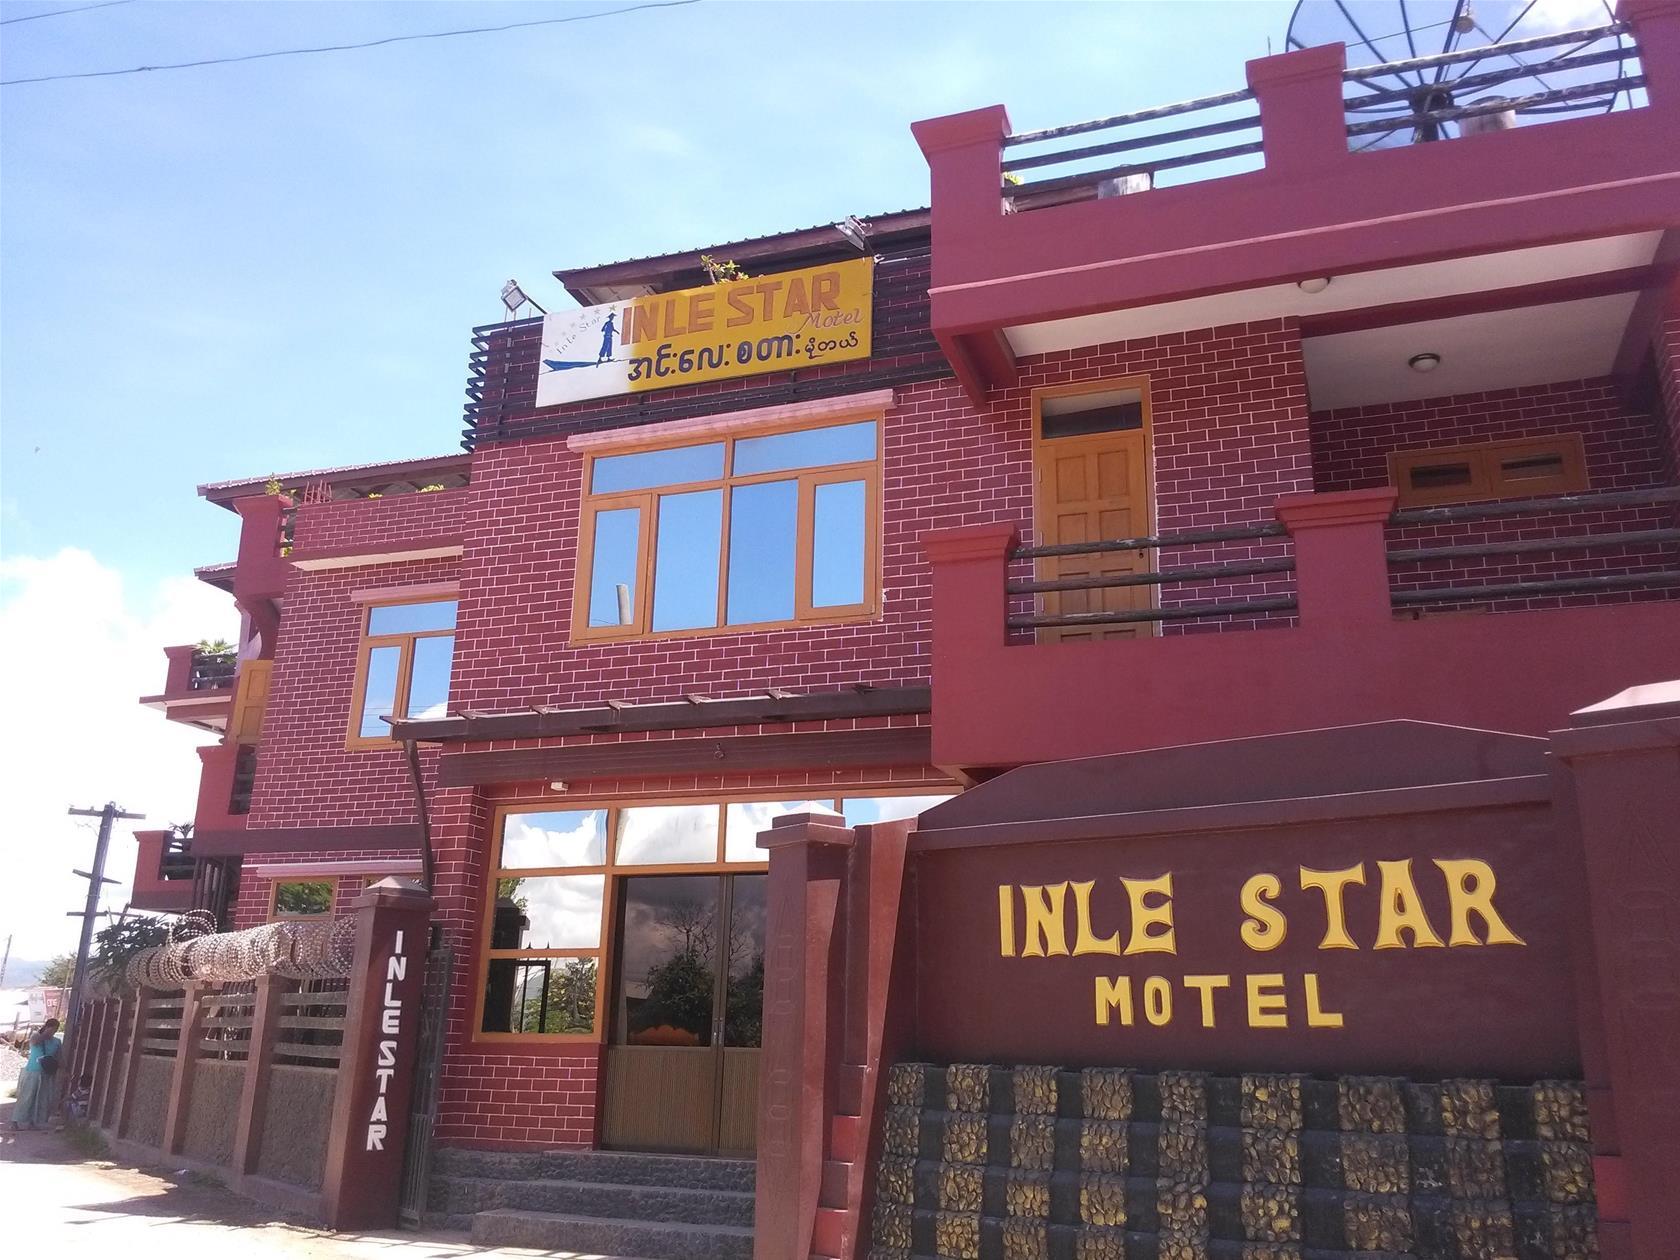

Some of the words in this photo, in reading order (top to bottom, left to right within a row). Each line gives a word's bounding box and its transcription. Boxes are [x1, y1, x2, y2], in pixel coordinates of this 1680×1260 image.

[621, 292, 715, 345] INLE
[727, 271, 840, 328] STAR
[790, 308, 862, 334] Motel
[999, 871, 1177, 958] INLE
[1240, 858, 1528, 952] STAR
[1095, 972, 1345, 1029] MOTEL
